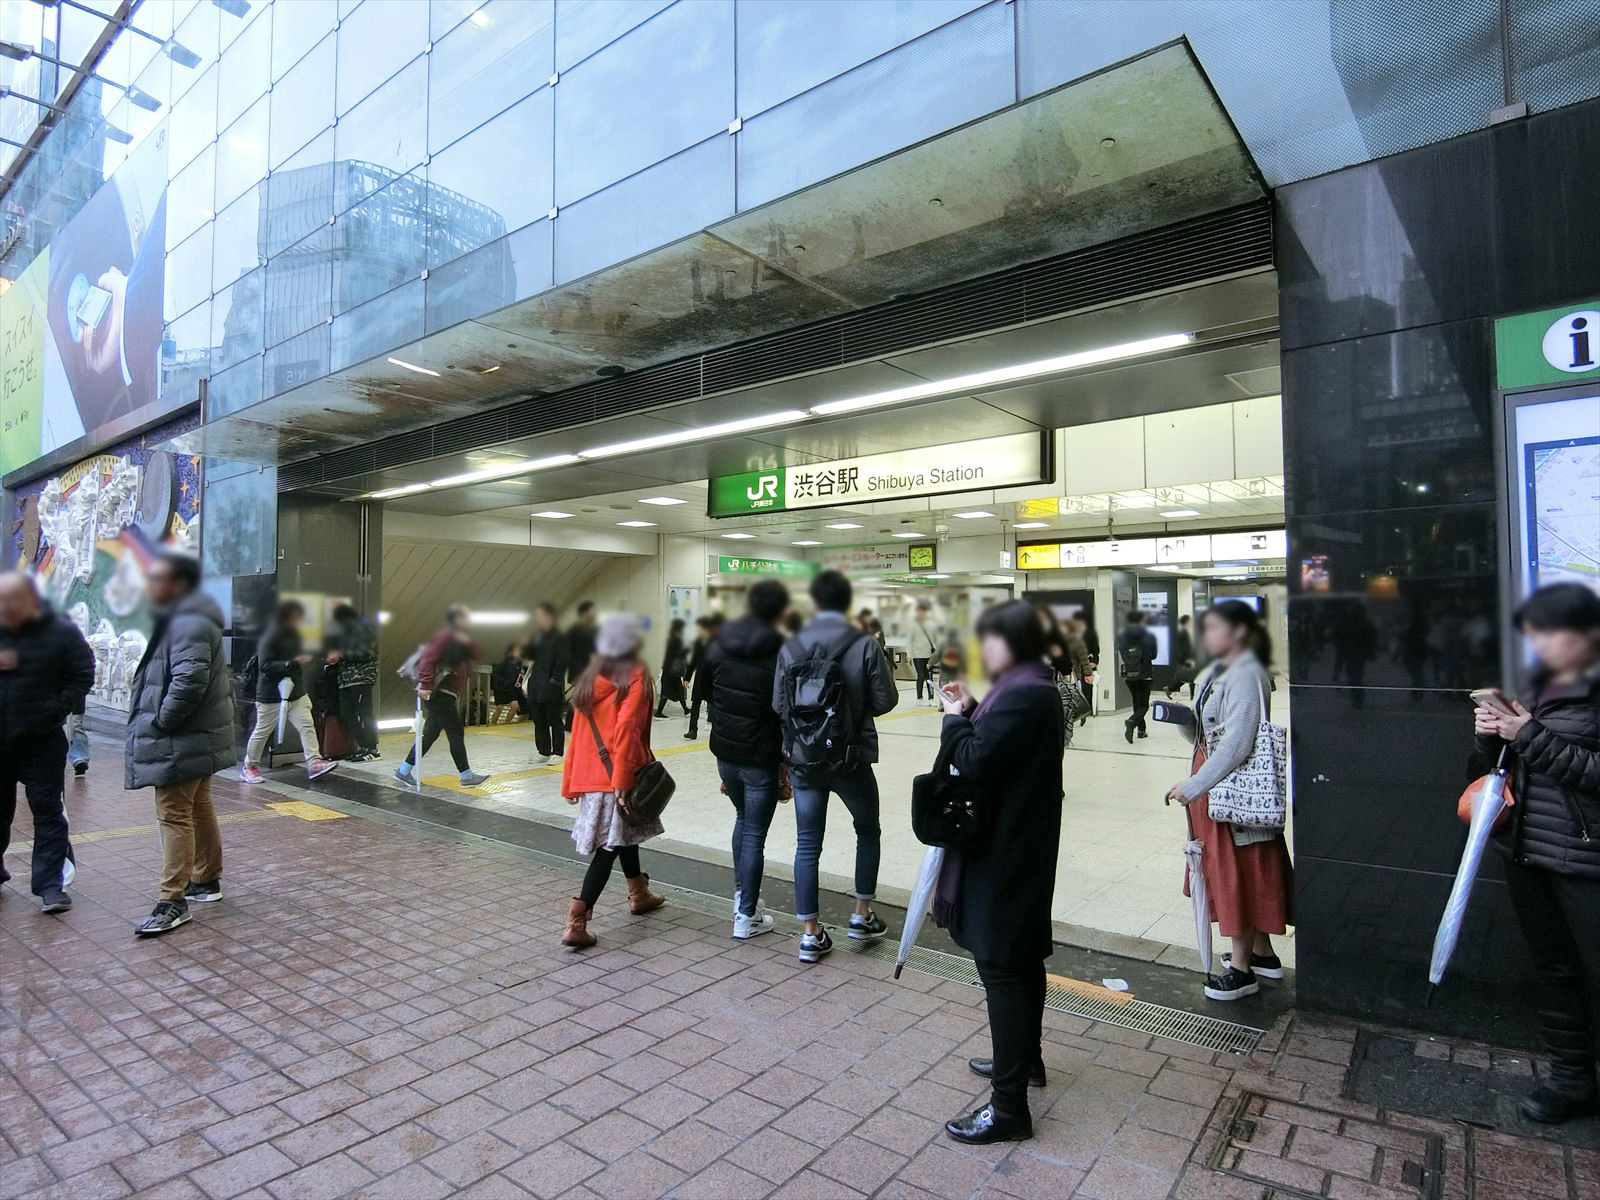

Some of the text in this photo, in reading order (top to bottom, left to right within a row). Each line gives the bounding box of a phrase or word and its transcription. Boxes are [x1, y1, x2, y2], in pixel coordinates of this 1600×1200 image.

[5, 304, 35, 356] スイスイ
[747, 475, 778, 500] JR
[794, 466, 985, 499] 渋谷駅 Shibuya Station
[728, 559, 740, 569] JR
